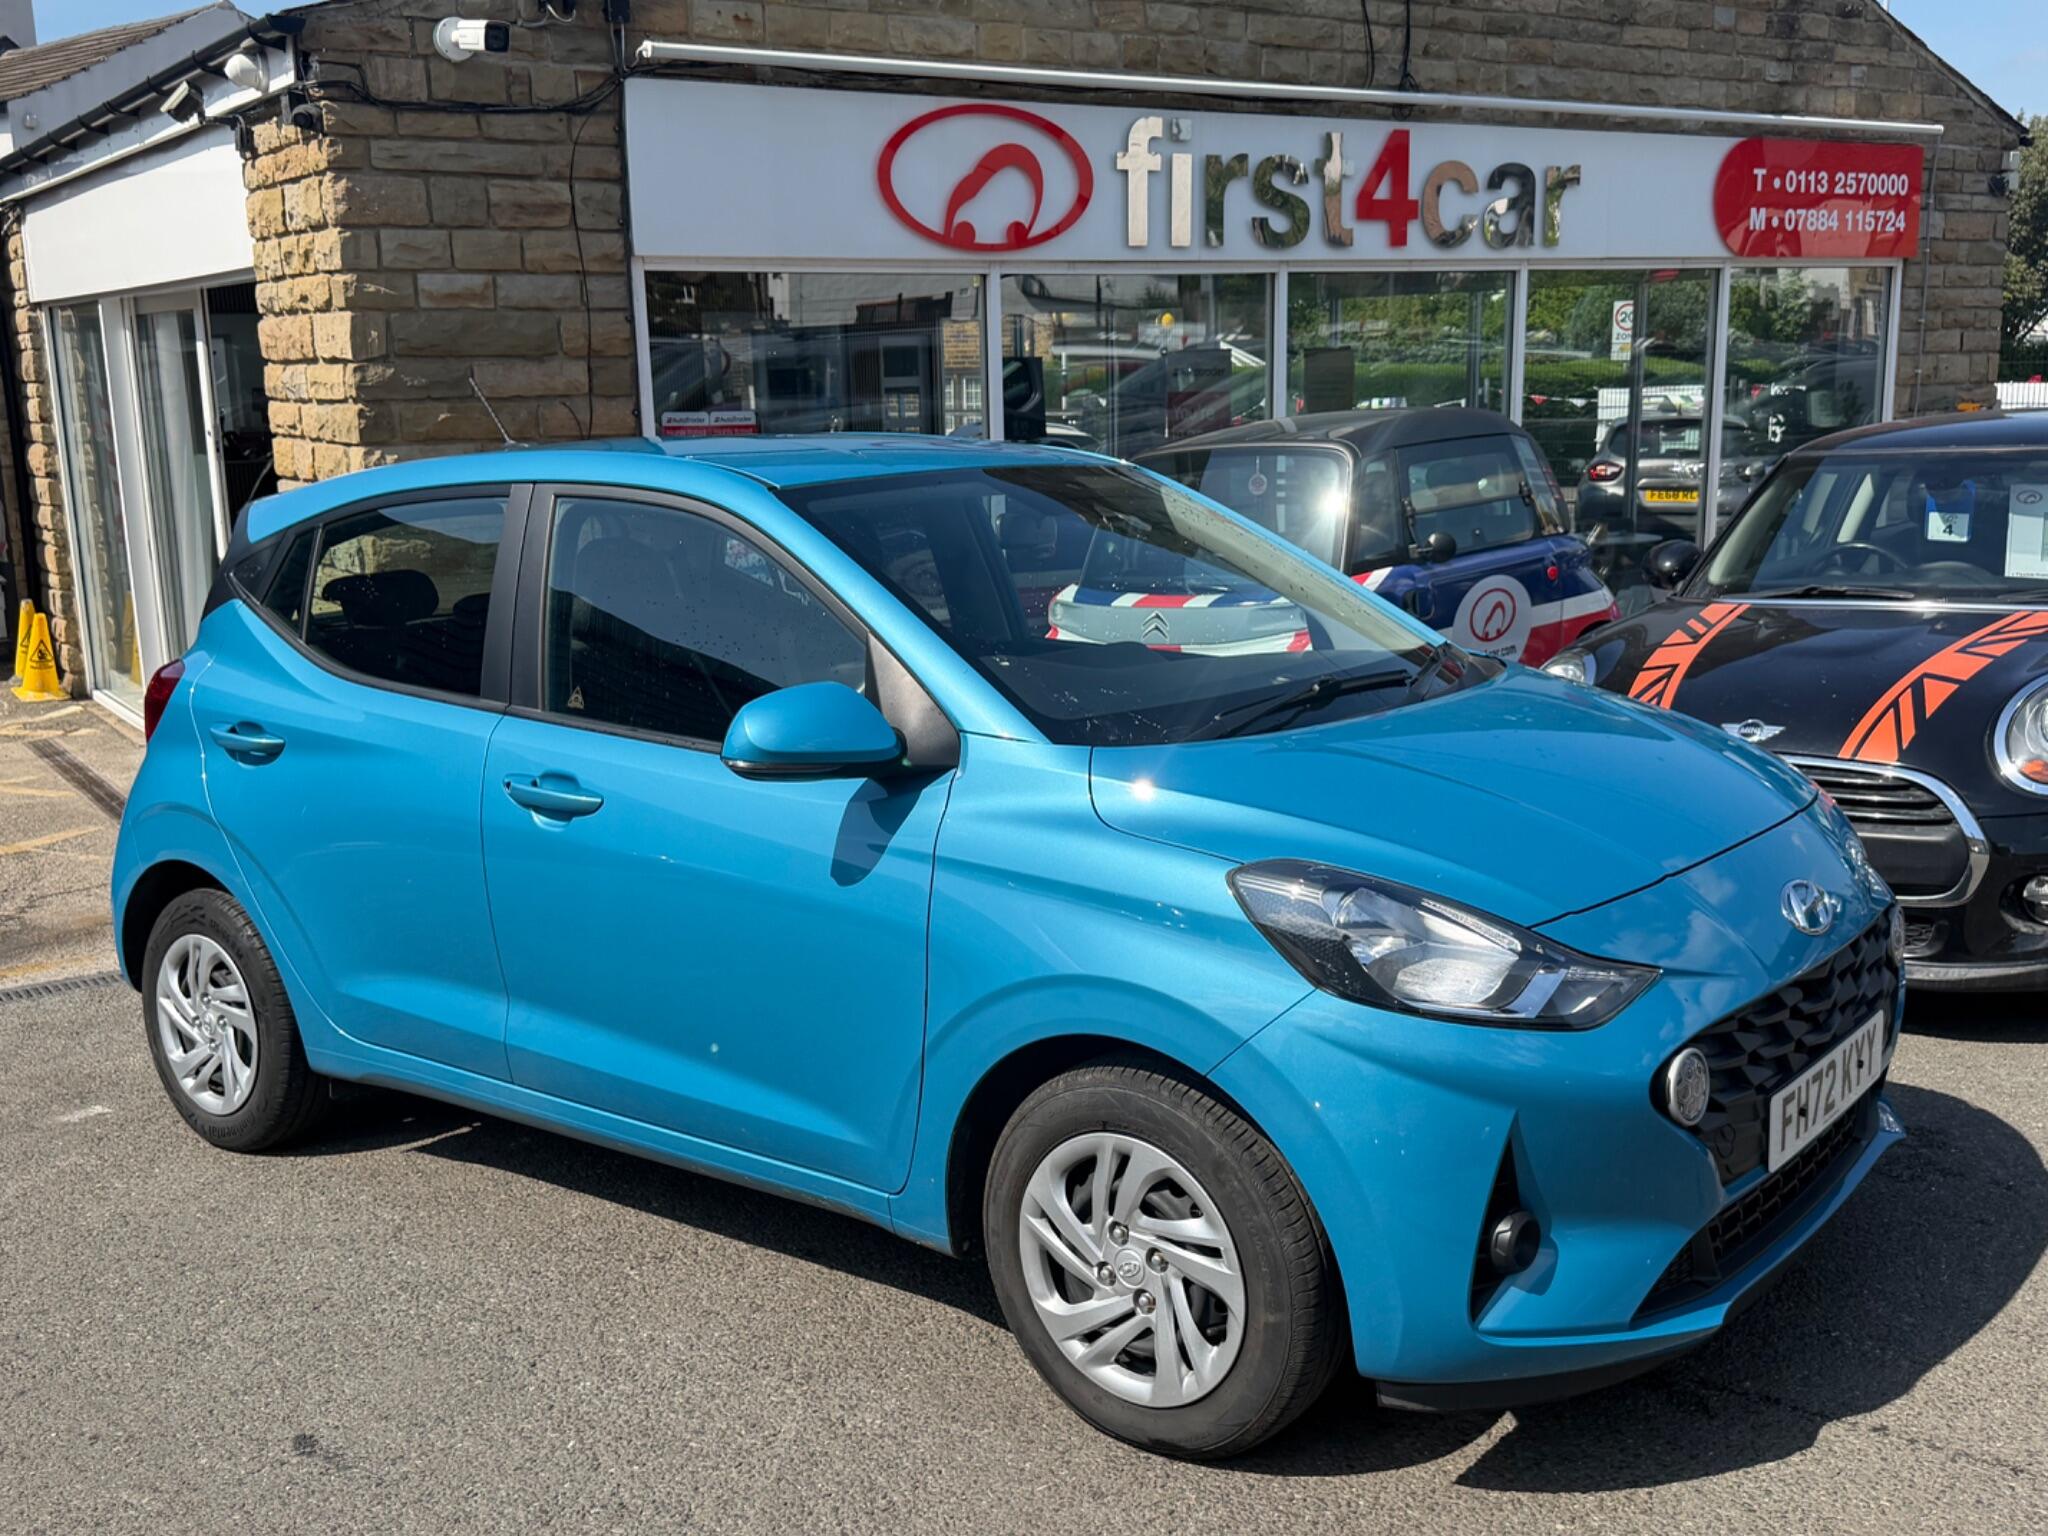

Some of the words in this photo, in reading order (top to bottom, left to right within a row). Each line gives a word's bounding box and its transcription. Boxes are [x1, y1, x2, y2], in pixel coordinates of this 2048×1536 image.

[1116, 116, 1581, 249] first4car
[1750, 207, 1767, 231] M
[1784, 208, 1839, 231] 07884
[1845, 210, 1906, 232] 115724
[1753, 168, 1767, 192] T
[1785, 170, 1828, 193] 0113
[1834, 172, 1909, 196] 2570000
[1780, 1059, 1837, 1152] FH72
[1841, 1023, 1877, 1101] KYY
